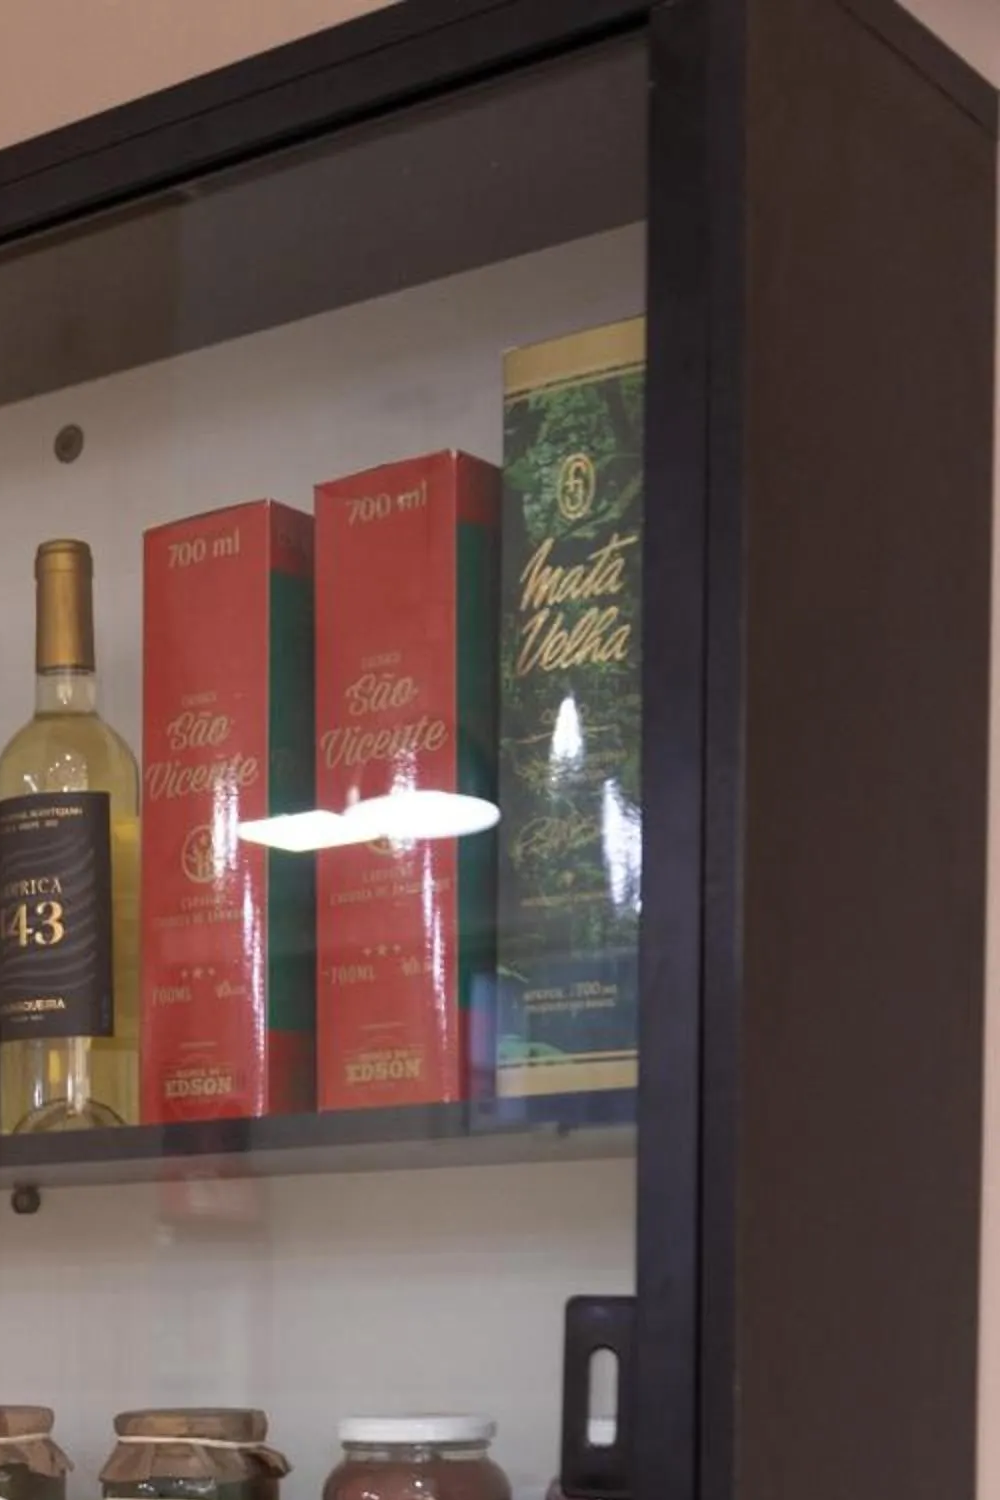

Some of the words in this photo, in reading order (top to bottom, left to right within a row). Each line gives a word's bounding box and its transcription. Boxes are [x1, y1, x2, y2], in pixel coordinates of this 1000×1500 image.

[346, 493, 391, 526] 700
[397, 481, 428, 509] ml
[168, 537, 207, 568] 700
[213, 528, 241, 556] ml
[516, 605, 632, 677] Velha
[344, 673, 419, 717] São
[166, 711, 235, 750] São
[320, 716, 448, 769] Vicente
[145, 753, 260, 800] Vicente
[164, 1075, 233, 1099] EDSON
[345, 1057, 422, 1084] EDSON
